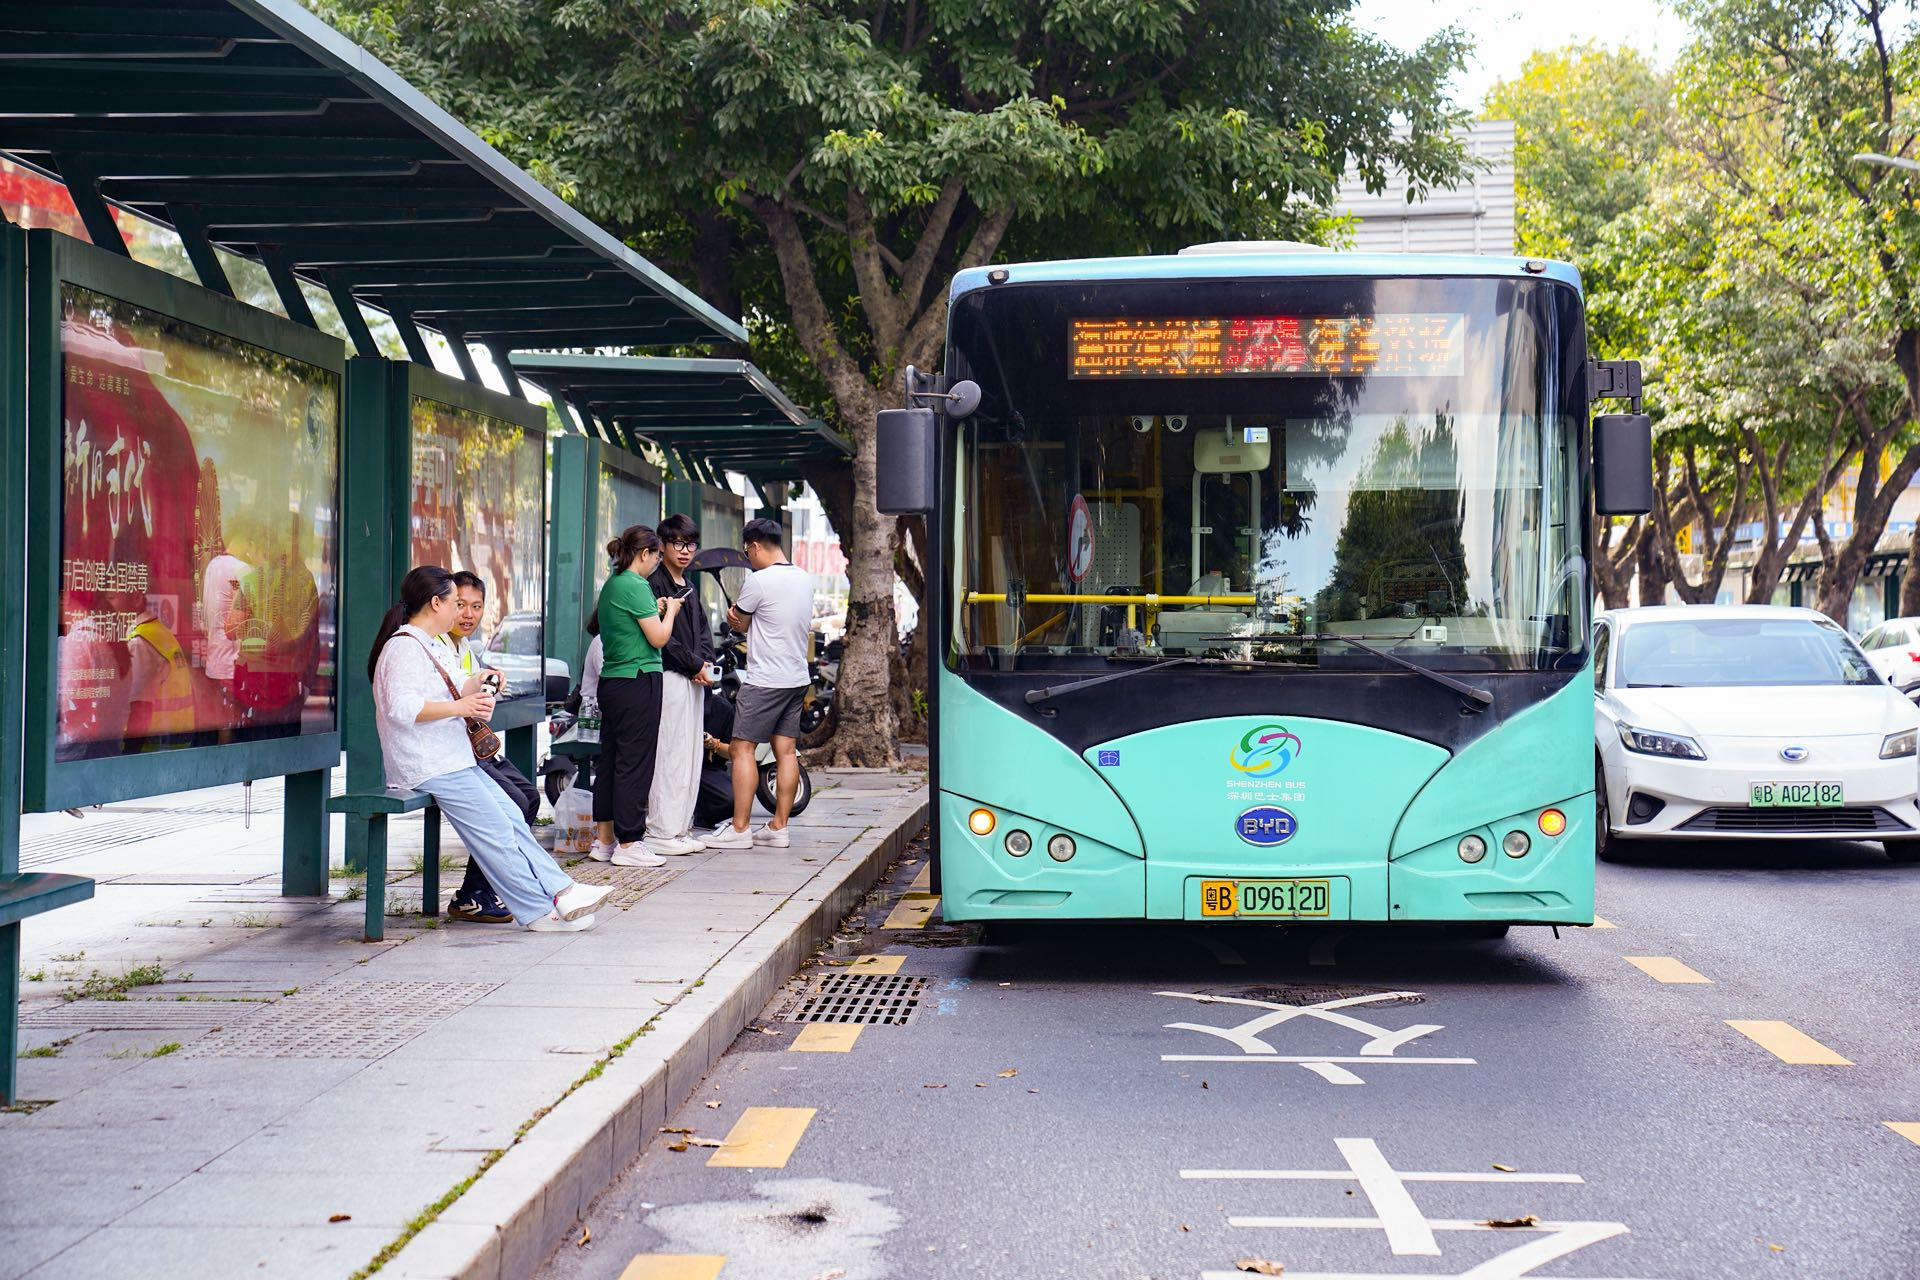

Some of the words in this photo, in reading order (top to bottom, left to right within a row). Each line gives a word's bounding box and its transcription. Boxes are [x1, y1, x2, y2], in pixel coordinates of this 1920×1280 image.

[65, 365, 94, 386] 爱生命
[63, 558, 148, 594] 开启创建全国禁毒
[1226, 780, 1281, 789] SHENZHEN
[1285, 781, 1306, 789] BUS
[1226, 791, 1306, 802] 深圳巴士集团
[1782, 785, 1841, 803] A02182
[1243, 818, 1290, 835] BYD
[1206, 886, 1232, 911] 粤B
[1244, 886, 1326, 911] 09612D
